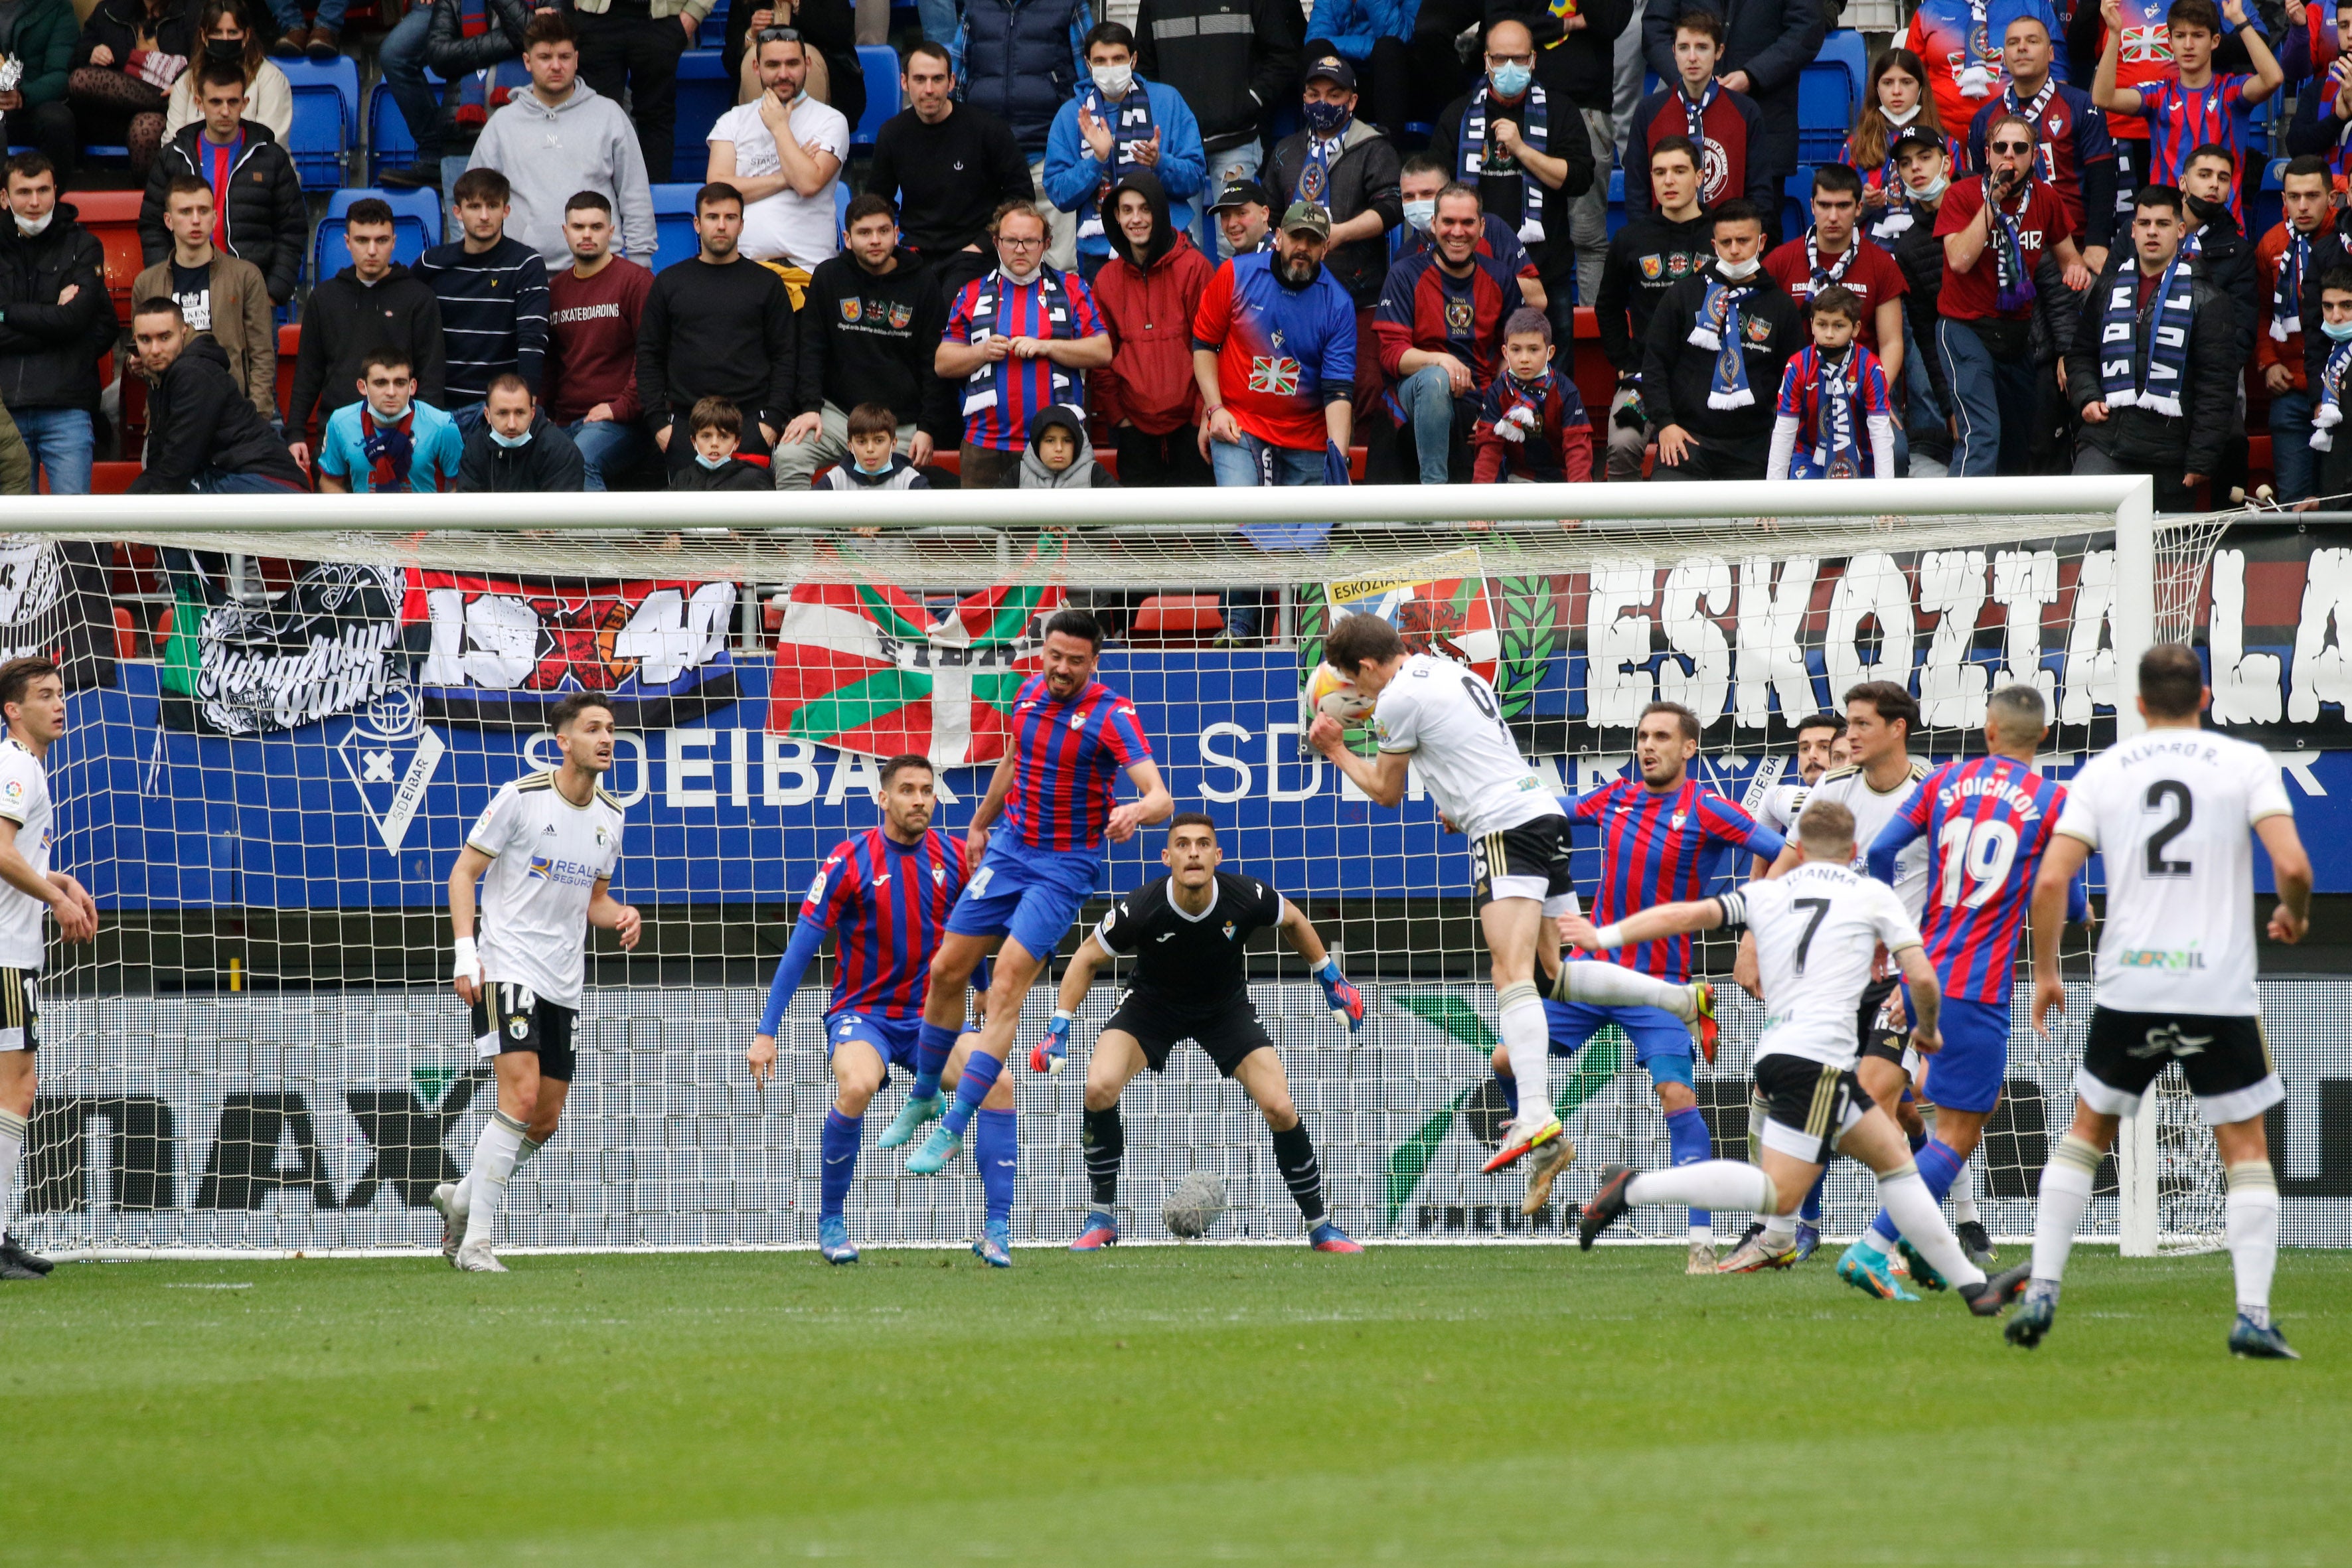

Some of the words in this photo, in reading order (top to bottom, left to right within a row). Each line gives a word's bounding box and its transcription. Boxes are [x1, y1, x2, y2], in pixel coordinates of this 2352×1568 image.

[1938, 776, 2041, 822] STOICHKOV
[2140, 779, 2192, 880] 2
[967, 866, 994, 900] 4
[1937, 816, 2019, 910] 19
[1789, 897, 1832, 979] 7
[501, 982, 536, 1015] 14
